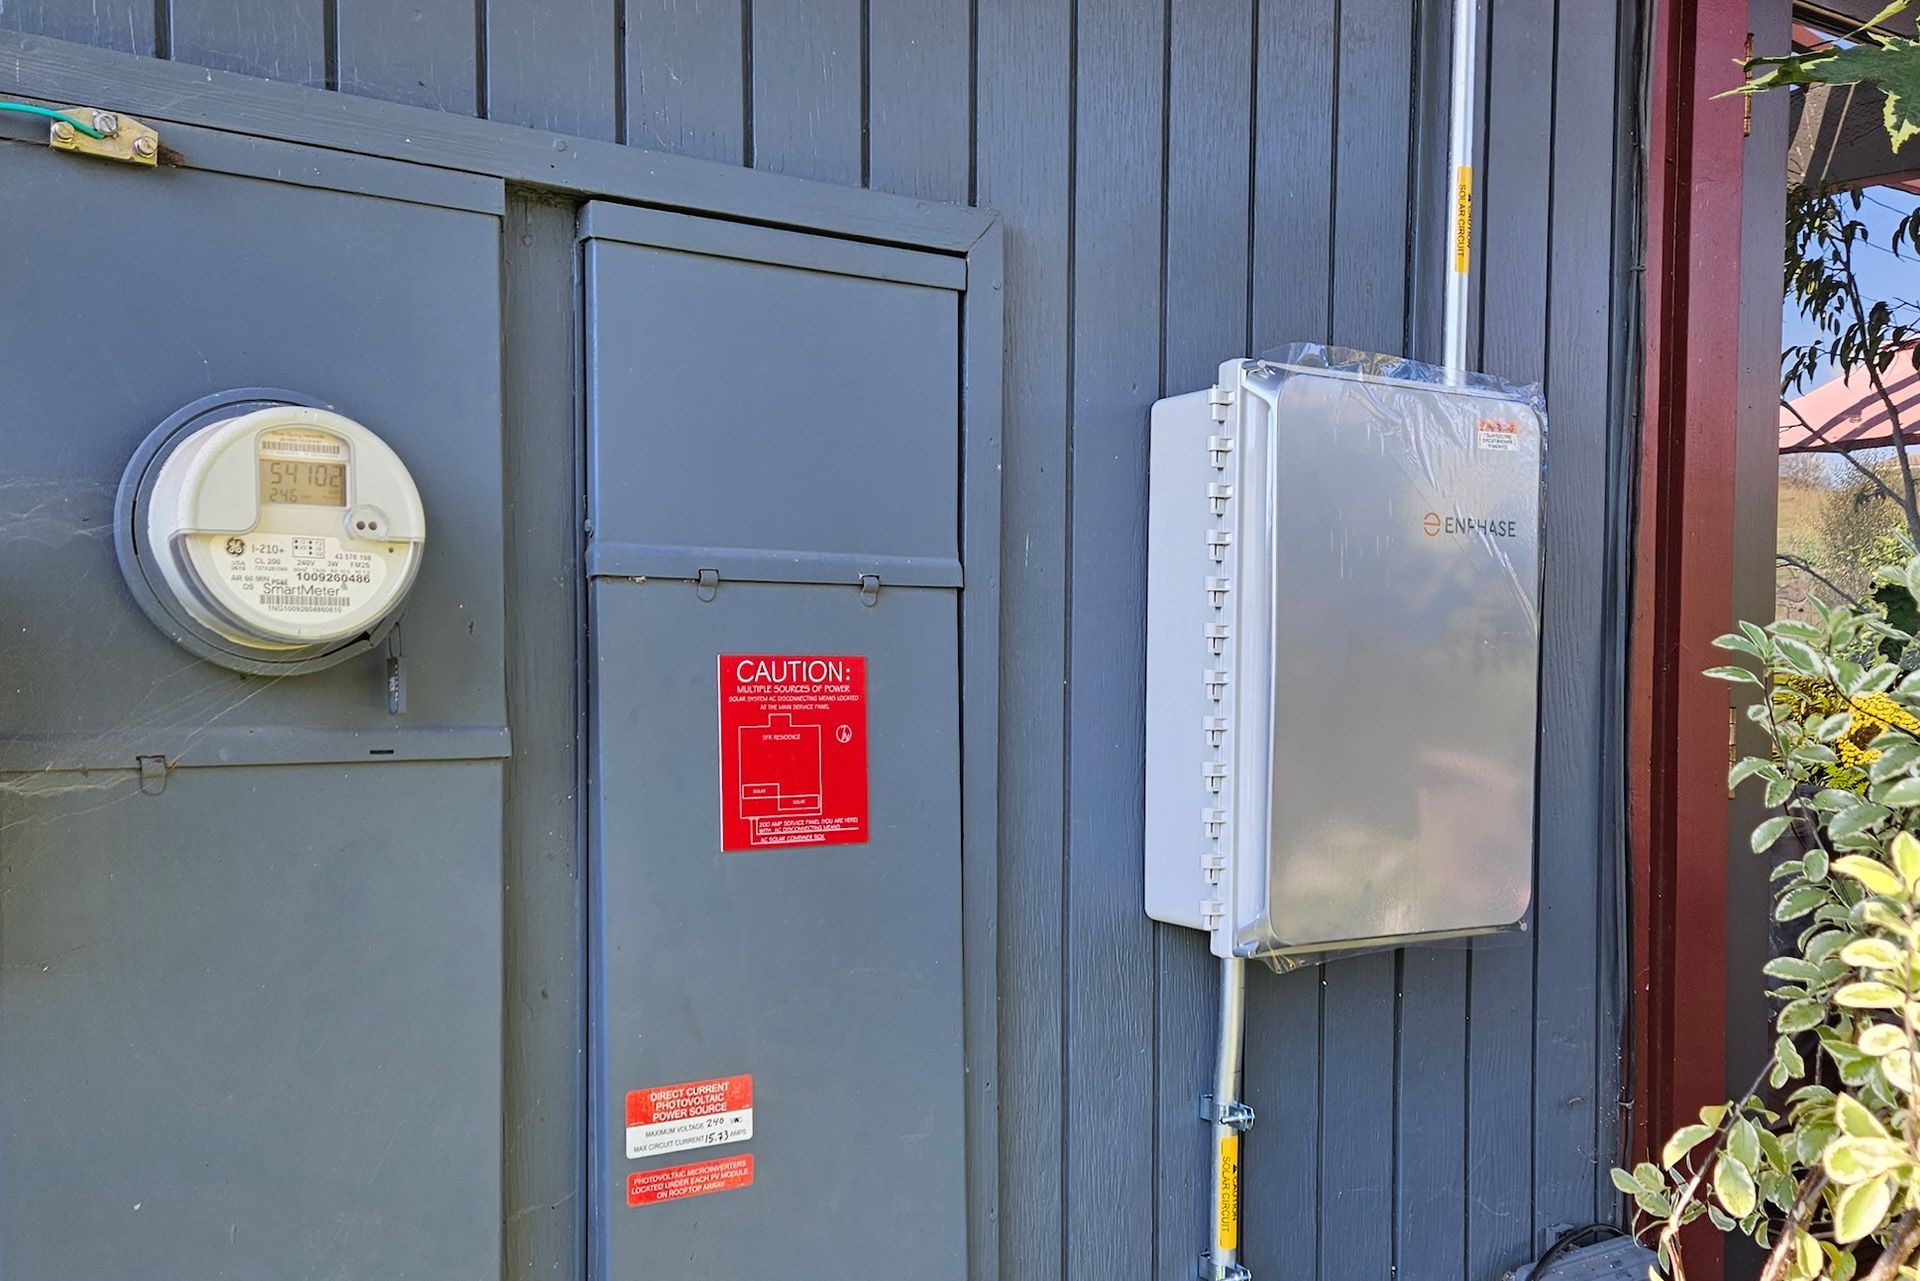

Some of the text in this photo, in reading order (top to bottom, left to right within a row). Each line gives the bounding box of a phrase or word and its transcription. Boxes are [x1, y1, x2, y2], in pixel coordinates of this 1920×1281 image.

[1457, 218, 1466, 257] CIRCUIT
[270, 462, 343, 488] 54102
[270, 487, 298, 503] 246
[1445, 516, 1516, 538] ENPHASE
[296, 572, 370, 583] 1009260486
[263, 582, 340, 596] SmartMeter
[736, 660, 850, 683] CAUTION:
[737, 684, 850, 693] MULTIPLE SOURCES OF POWER
[650, 1082, 730, 1102] DIRECT CURRENT
[656, 1093, 724, 1111] PHOTOVOLTAIC
[652, 1103, 727, 1122] POWER SOURCE
[645, 1128, 675, 1137] MAXIMUM
[677, 1123, 704, 1133] VOLTAGE
[706, 1118, 724, 1128] 240
[633, 1145, 647, 1153] MAX
[648, 1140, 673, 1150] CIRCUIT
[674, 1136, 704, 1146] CURRENT
[631, 1184, 664, 1195] LOCATED
[665, 1181, 689, 1192] UNDER
[691, 1177, 710, 1186] EACH
[720, 1168, 748, 1180] MODULE
[633, 1160, 746, 1185] PHOTOVOLTAIC MICROINVERTERS
[668, 1187, 702, 1197] ROOFTOP
[702, 1181, 725, 1191] ARRAY
[1221, 1156, 1230, 1232] SOLAR CIRCUIT
